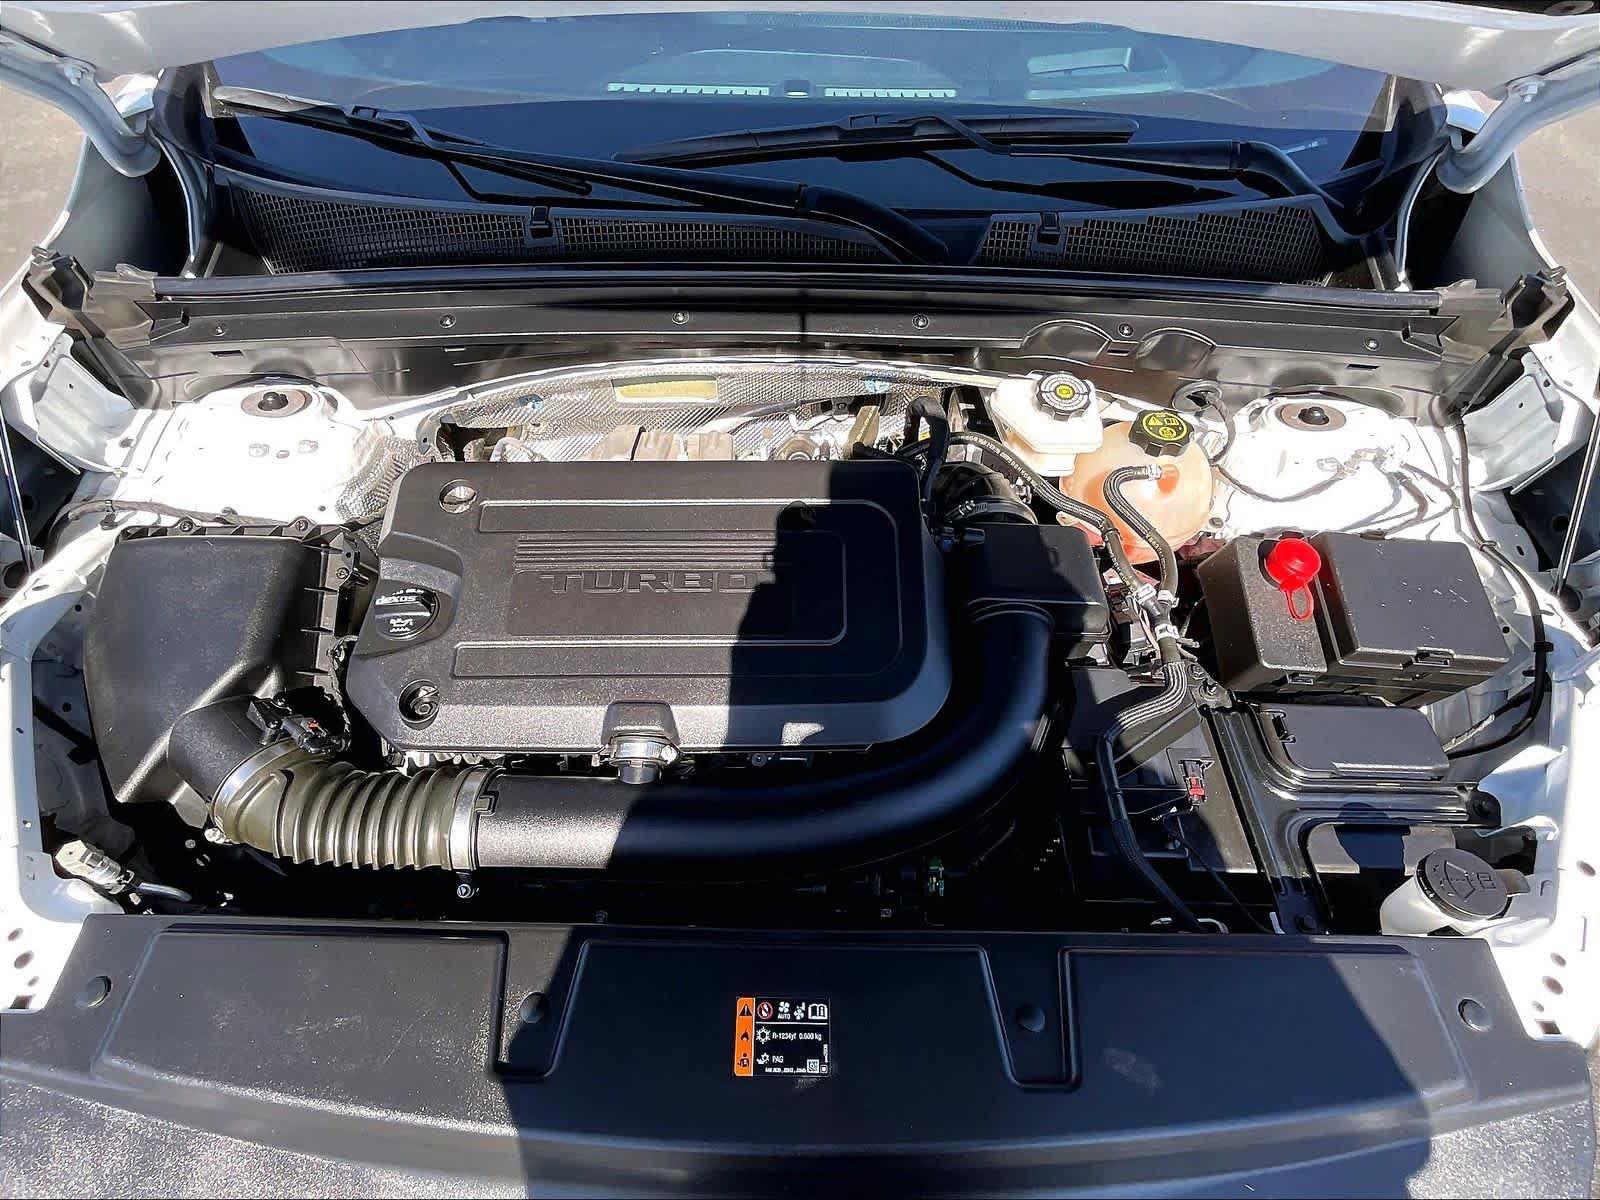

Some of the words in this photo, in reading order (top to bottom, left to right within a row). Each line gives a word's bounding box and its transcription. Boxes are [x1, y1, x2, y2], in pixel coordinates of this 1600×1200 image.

[540, 569, 758, 593] TURBO
[375, 595, 418, 605] dexos
[772, 1032, 797, 1041] R-1234yf
[814, 1032, 822, 1041] kg
[772, 1055, 784, 1063] PAG
